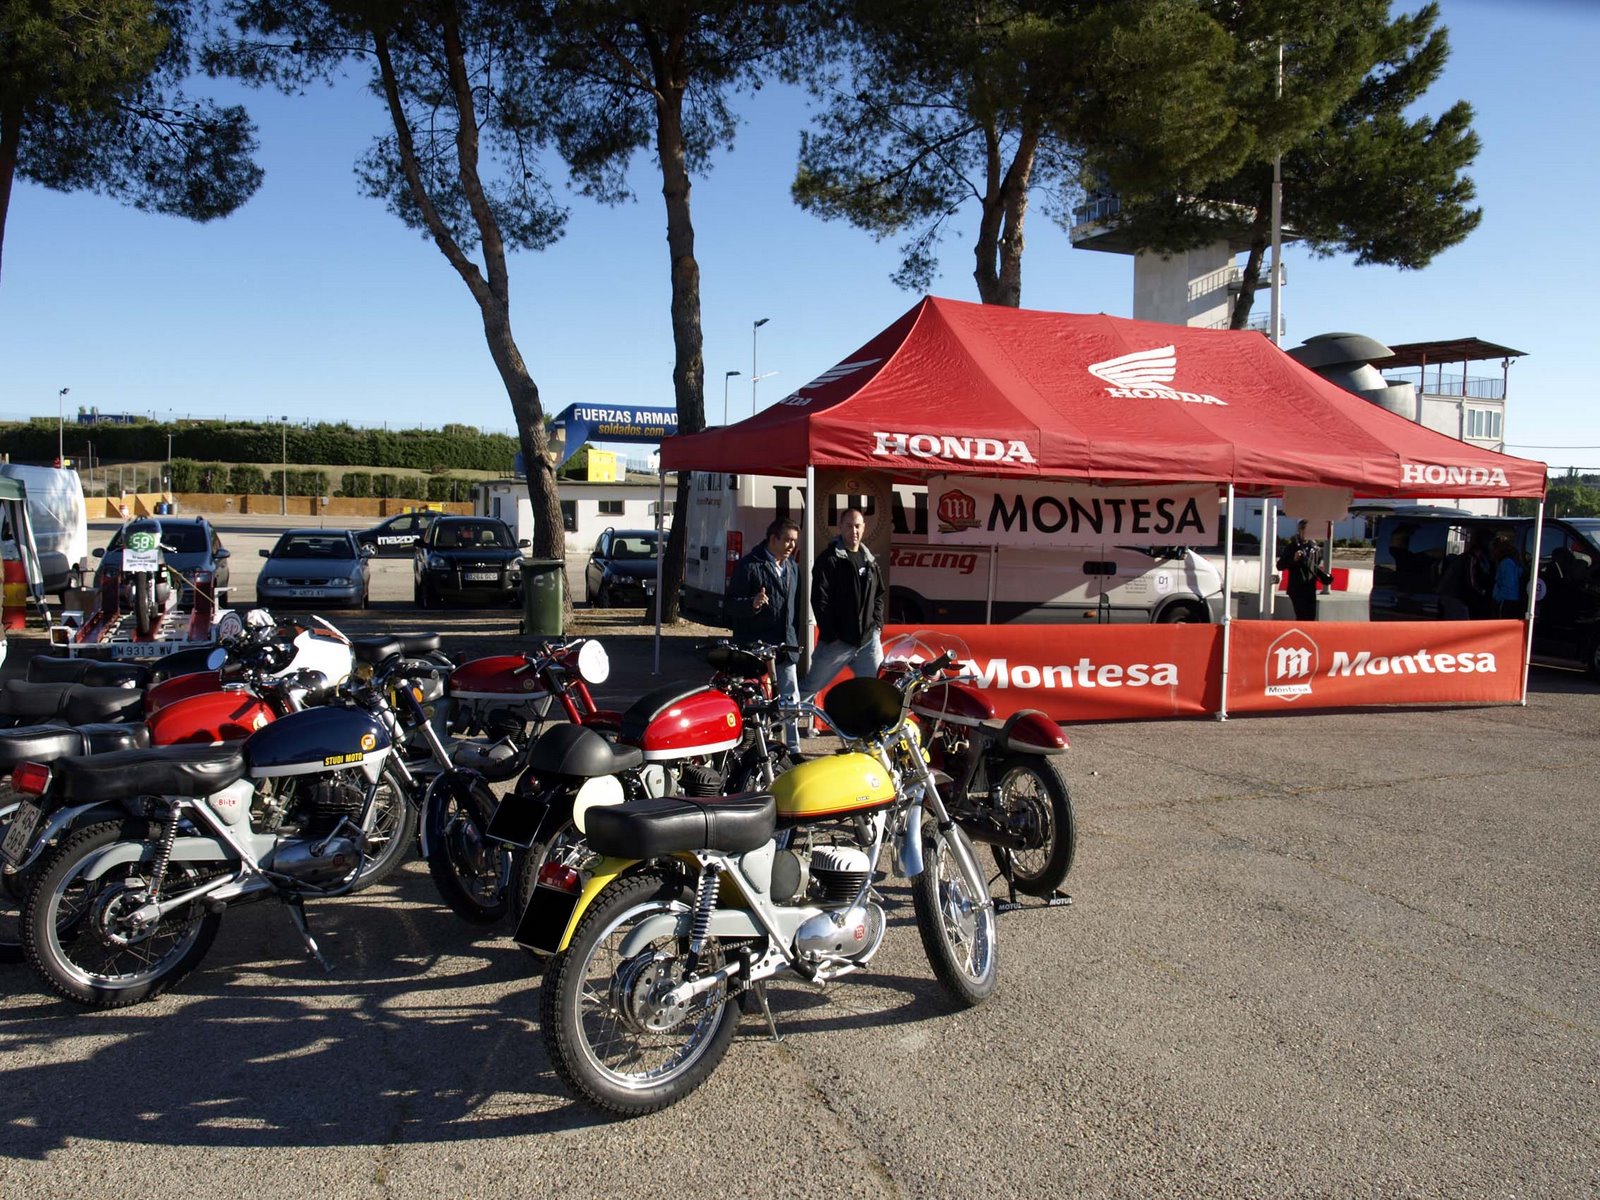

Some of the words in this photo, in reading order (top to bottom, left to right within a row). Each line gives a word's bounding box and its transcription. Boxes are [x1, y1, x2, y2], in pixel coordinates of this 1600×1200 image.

[1104, 387, 1229, 406] HONDA
[574, 408, 631, 423] FUERZAS
[598, 423, 665, 437] soldados.com
[872, 431, 1037, 464] HONDA
[1401, 464, 1510, 487] HONDA
[987, 493, 1206, 535] MONTESA
[132, 536, 150, 549] 58
[890, 549, 978, 575] Racing
[1158, 575, 1169, 585] 01
[127, 644, 155, 656] 9313
[1327, 649, 1497, 678] Montesa
[957, 657, 1179, 689] Montesa
[1268, 686, 1308, 694] Montesa
[345, 752, 363, 763] MOTO
[998, 902, 1022, 911] MOTUL
[1049, 898, 1073, 906] MOTUL
